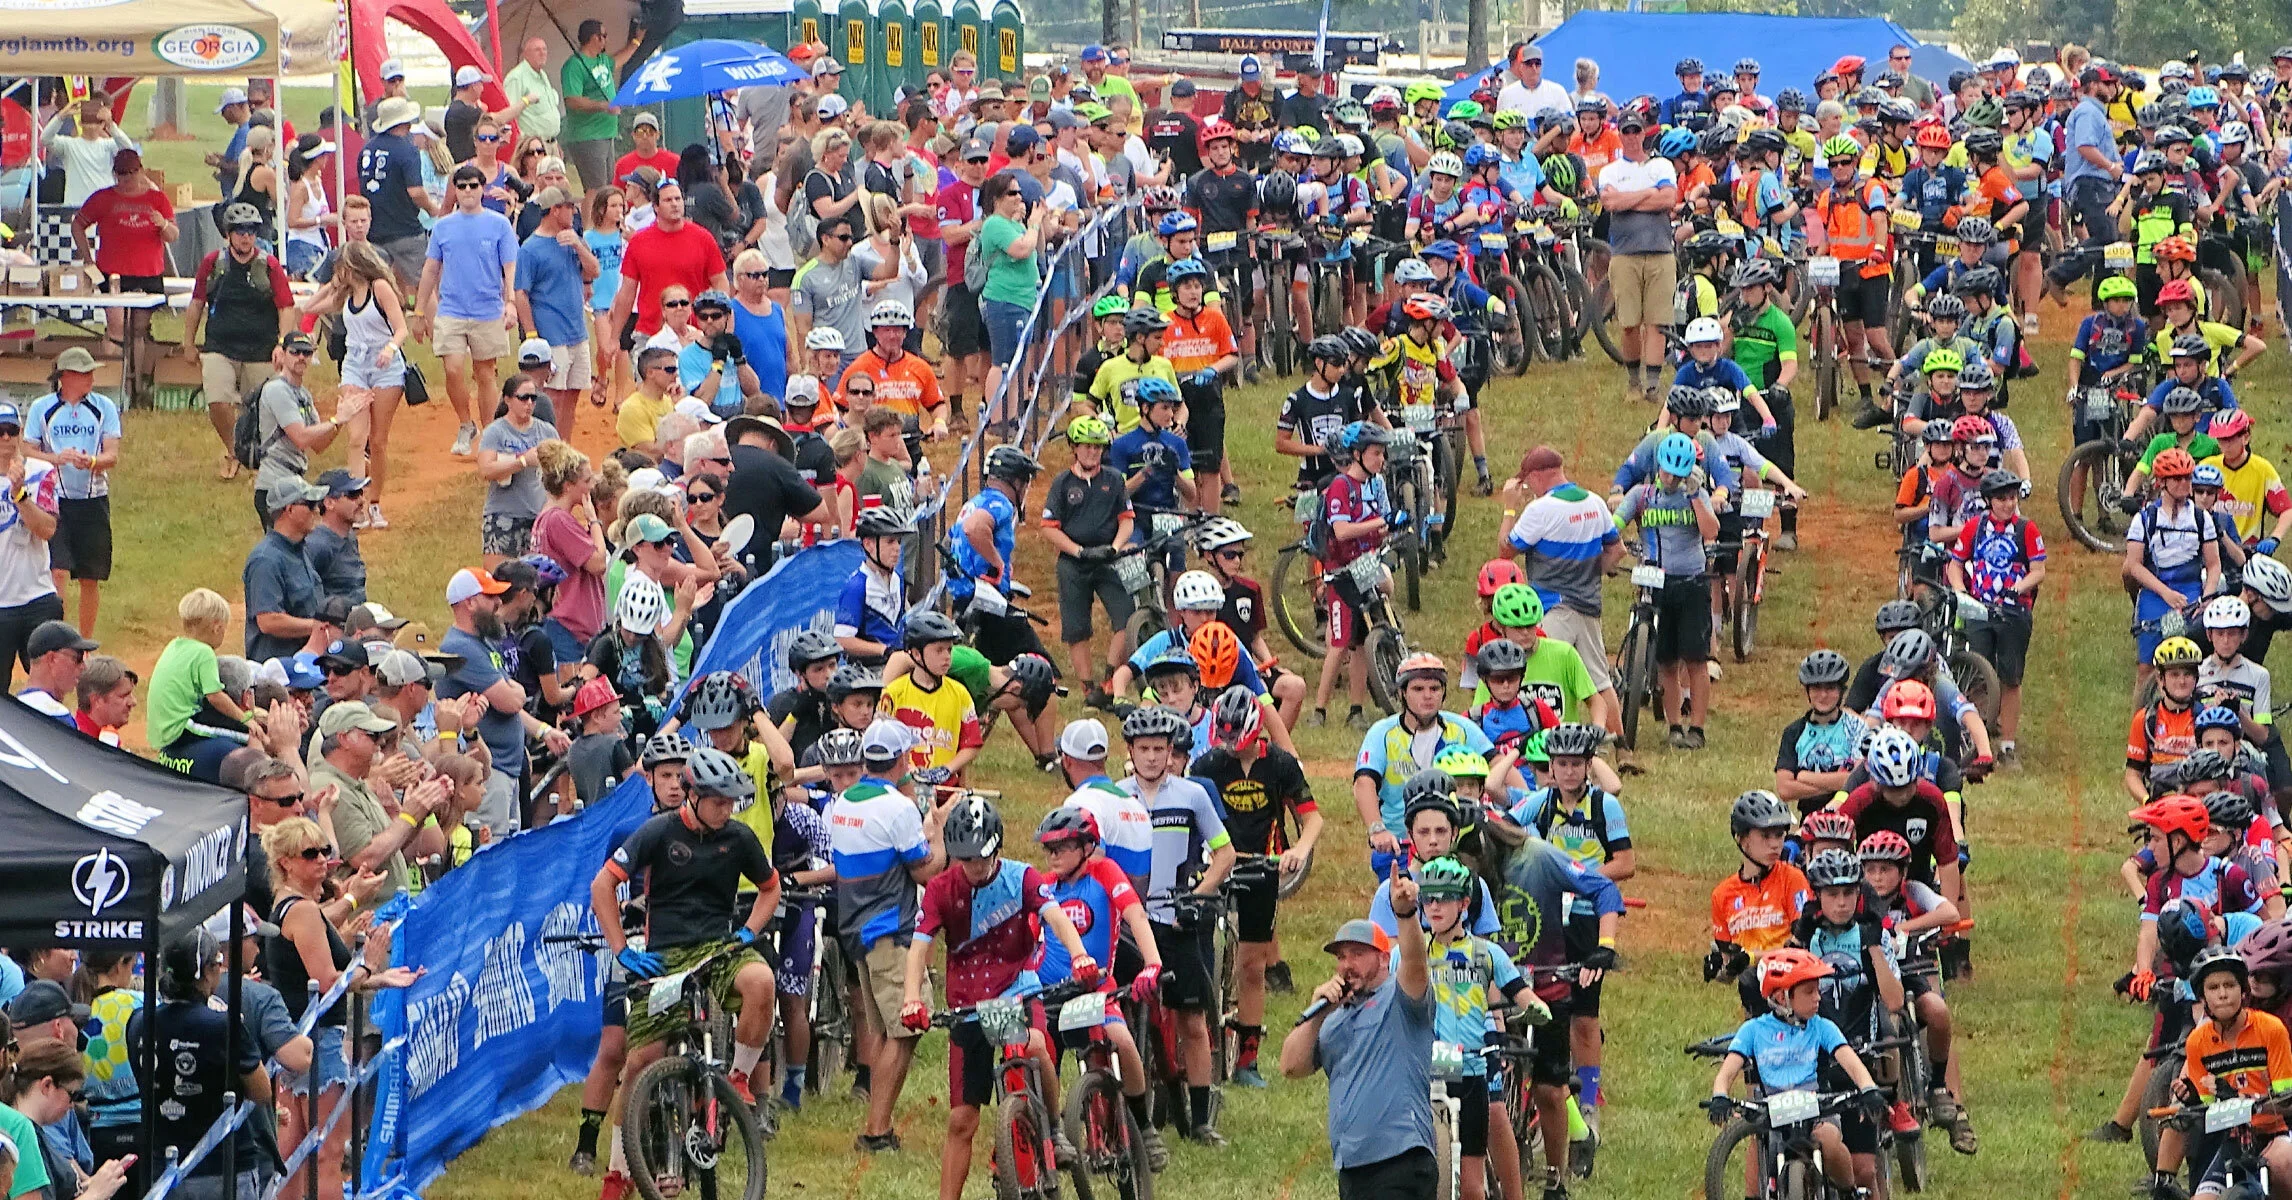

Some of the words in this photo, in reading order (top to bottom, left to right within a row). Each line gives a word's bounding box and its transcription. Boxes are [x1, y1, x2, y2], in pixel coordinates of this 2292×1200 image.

[164, 39, 255, 56] GEORGIA
[849, 21, 864, 48] NIX
[888, 25, 903, 52] NIX
[923, 22, 937, 50] NIX
[1001, 29, 1015, 57] NIX
[1219, 39, 1258, 51] HALL
[54, 926, 143, 946] STRIKE
[379, 1050, 402, 1145] SHIMANO
